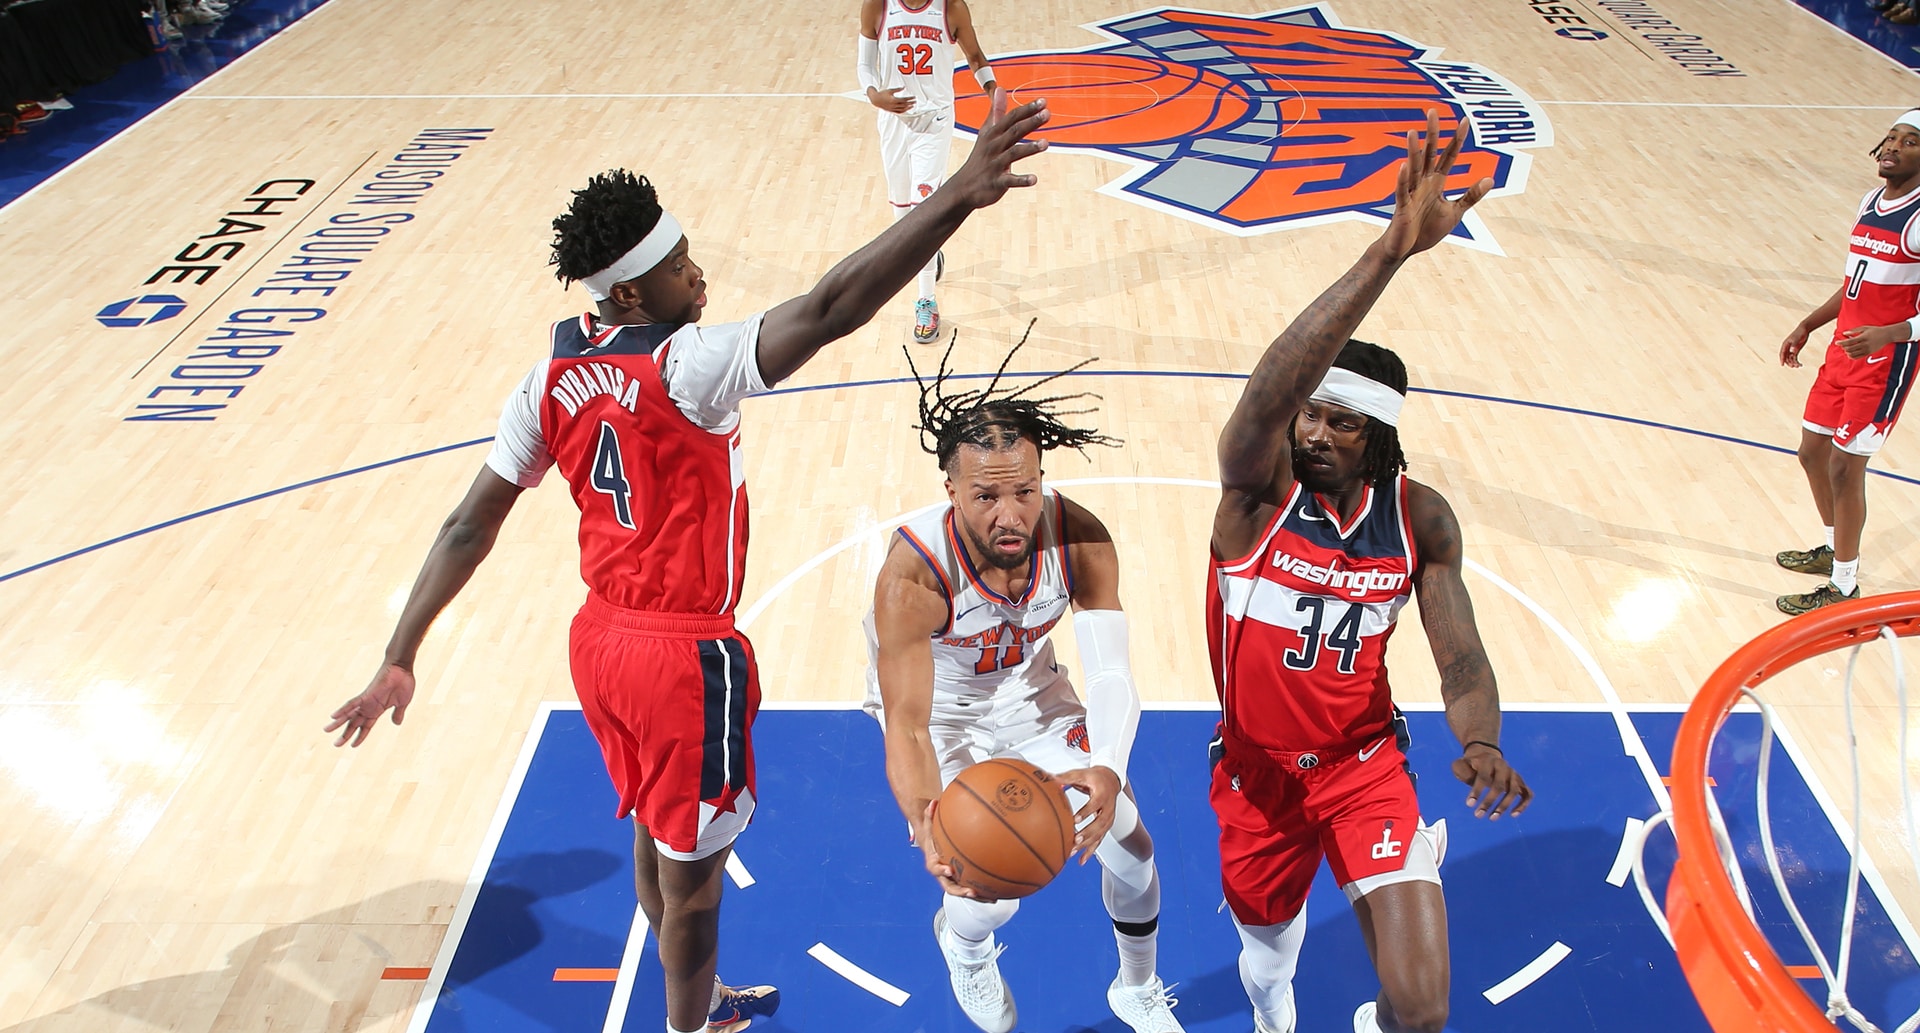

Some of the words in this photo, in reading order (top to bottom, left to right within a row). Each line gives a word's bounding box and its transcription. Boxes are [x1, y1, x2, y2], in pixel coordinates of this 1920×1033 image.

[888, 25, 913, 41] NEW
[913, 25, 942, 43] YORK
[896, 43, 933, 75] 32
[1597, 0, 1681, 31] QUARE
[1642, 34, 1747, 77] GARDEN
[1157, 11, 1500, 223] KNICKS
[1415, 62, 1513, 96] NEW
[1465, 100, 1536, 145] YORK
[347, 128, 495, 204] MADISON
[142, 178, 316, 285] CHASE
[251, 213, 415, 297] SQUARE
[1846, 259, 1868, 299] 0
[123, 307, 328, 422] GARDEN
[550, 362, 640, 418] DYBANTSA
[590, 420, 637, 531] 4
[1272, 550, 1406, 597] washington
[939, 621, 1007, 648] NEW
[1007, 615, 1062, 643] YOR
[975, 645, 1024, 675] 11
[1282, 596, 1364, 674] 34
[1371, 828, 1402, 859] dc
